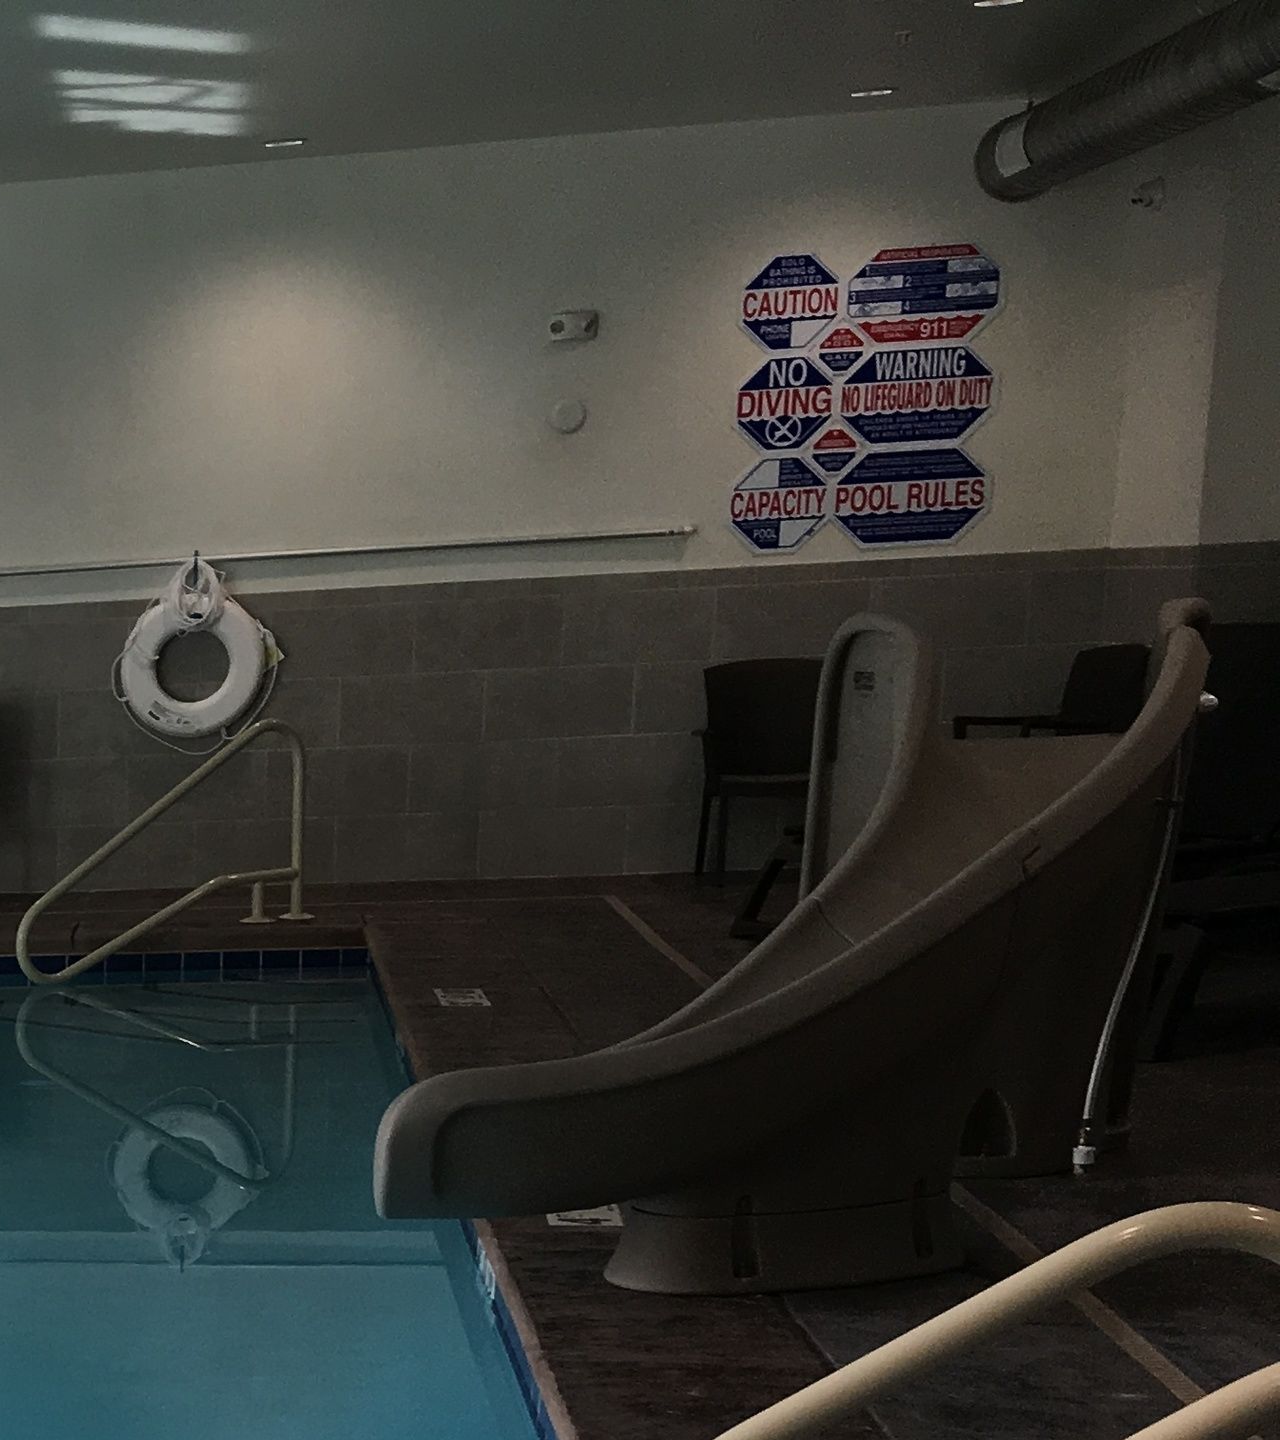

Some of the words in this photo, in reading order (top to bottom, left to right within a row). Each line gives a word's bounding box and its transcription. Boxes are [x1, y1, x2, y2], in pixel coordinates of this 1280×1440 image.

[781, 258, 805, 266] SOLO
[762, 275, 822, 286] PROHIBITED
[905, 277, 912, 286] 2
[743, 287, 838, 318] CAUTION
[849, 293, 856, 303] 3
[760, 324, 789, 333] PHONE
[920, 320, 947, 337] 911
[769, 358, 807, 388] NO
[875, 348, 967, 380] WARNING
[737, 386, 832, 419] DIVING
[841, 386, 860, 413] NO
[864, 381, 932, 412] LIFEGUARD
[936, 380, 956, 406] ON
[959, 377, 993, 406] DUTY
[731, 489, 825, 518] CAPACITY
[835, 485, 898, 513] POOL
[907, 479, 985, 508] RULES
[753, 529, 776, 538] POOL
